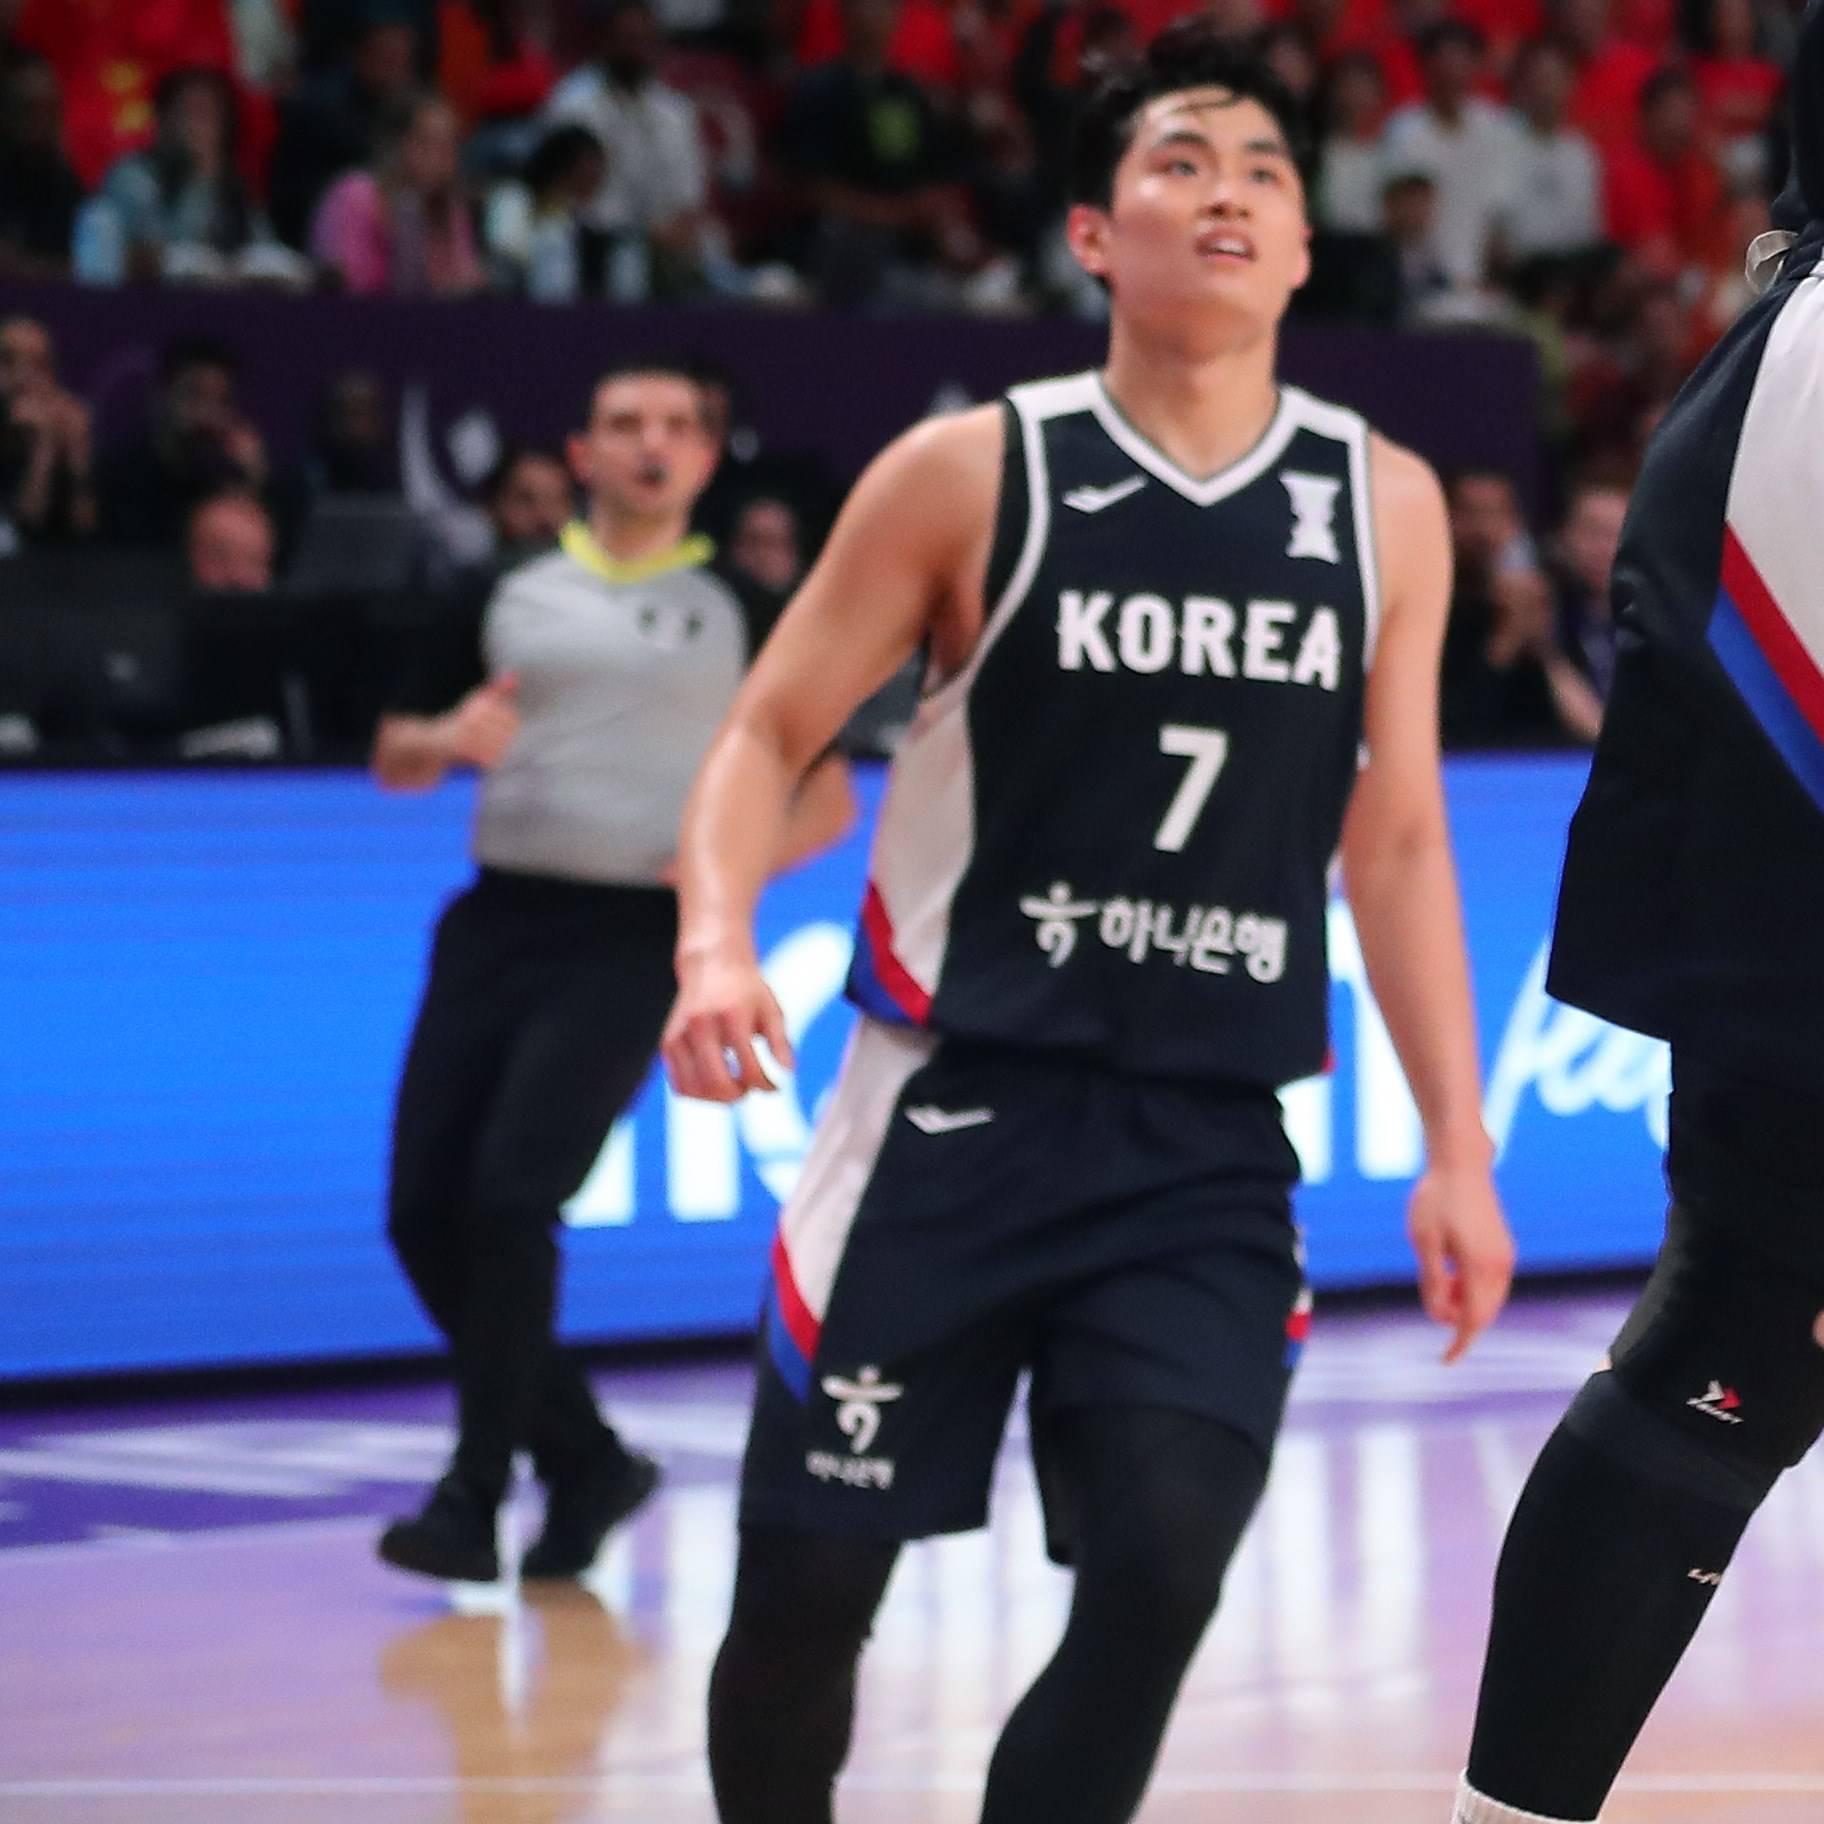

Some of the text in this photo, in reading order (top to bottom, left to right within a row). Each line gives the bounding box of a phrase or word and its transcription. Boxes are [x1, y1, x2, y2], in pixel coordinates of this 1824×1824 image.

[1056, 589, 1341, 692] KOREA
[1153, 724, 1228, 852] 7
[1099, 894, 1287, 984] 하나은행
